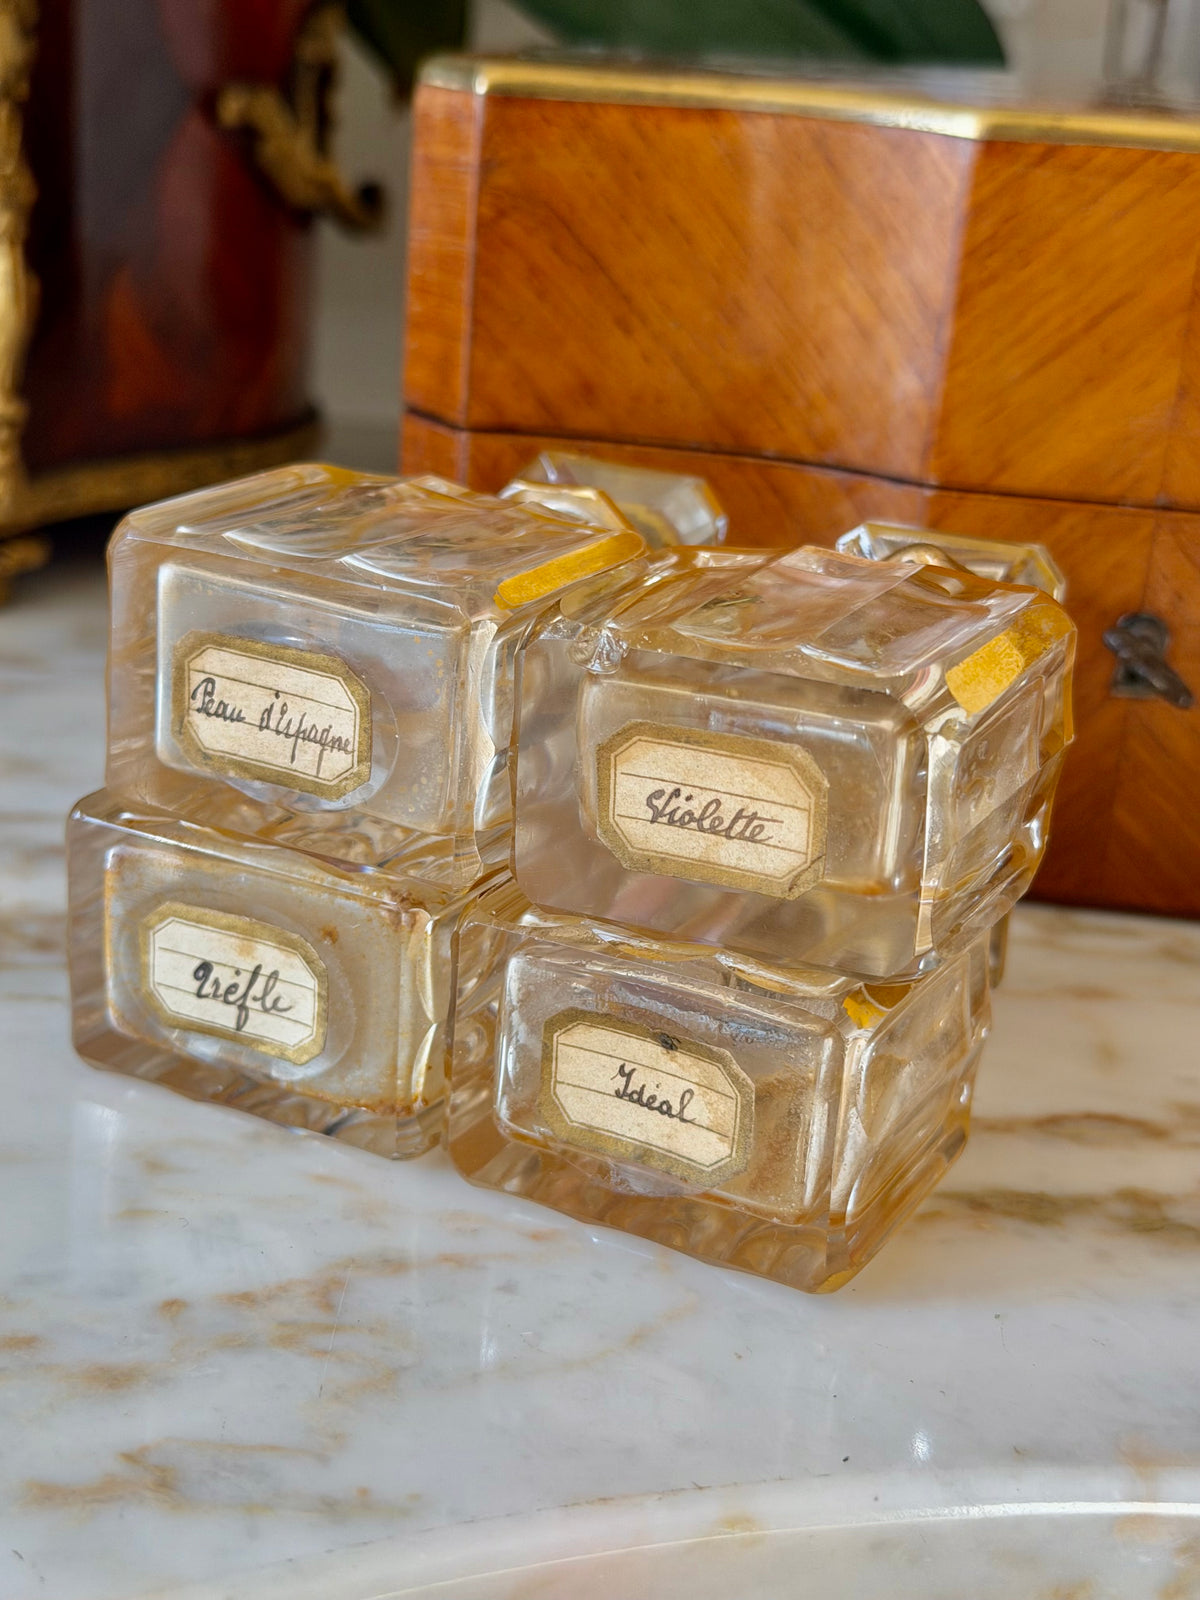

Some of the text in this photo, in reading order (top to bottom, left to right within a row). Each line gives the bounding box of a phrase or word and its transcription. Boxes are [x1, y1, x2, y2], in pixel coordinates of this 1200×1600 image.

[191, 677, 246, 722] Peau
[645, 788, 784, 842] Violette
[610, 1062, 697, 1123] Idéal
